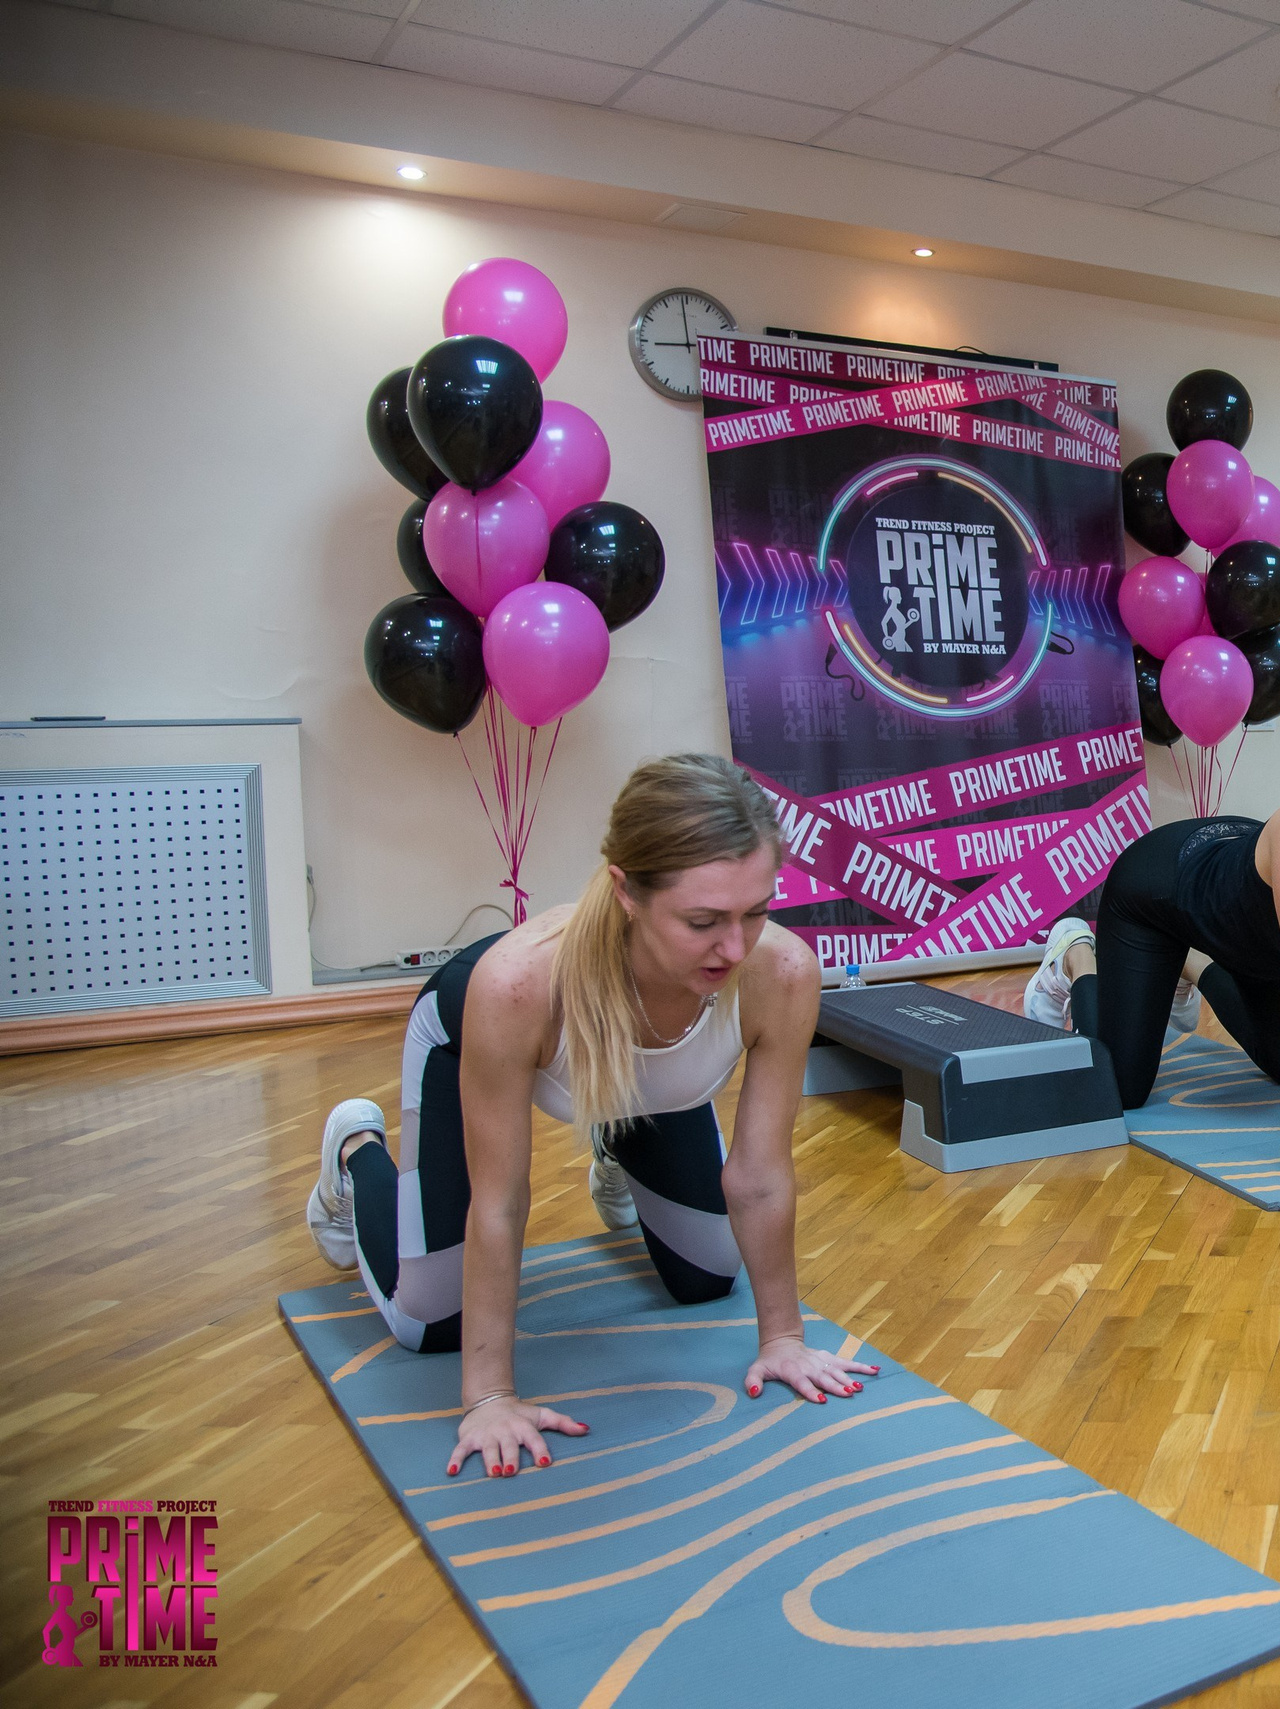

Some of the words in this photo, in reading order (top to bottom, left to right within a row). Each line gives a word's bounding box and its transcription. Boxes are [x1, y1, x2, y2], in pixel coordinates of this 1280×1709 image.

[750, 343, 834, 374] PRIMETIME
[846, 355, 925, 384] PRIMETIME
[707, 409, 796, 447] PRIMETIME
[802, 395, 885, 429] PRIMETIME
[891, 380, 969, 414] PRIMETIME
[973, 419, 1044, 453] PRIMETIME
[1053, 401, 1120, 455] PRIMETIME
[876, 517, 909, 530] TREND
[911, 520, 952, 532] FITNESS
[954, 523, 995, 536] PROJECT
[913, 586, 1005, 642] TIME
[923, 643, 940, 653] BY
[942, 643, 980, 654] MAYER
[982, 645, 1006, 655] N&A
[949, 747, 1066, 808] PRIMETIME
